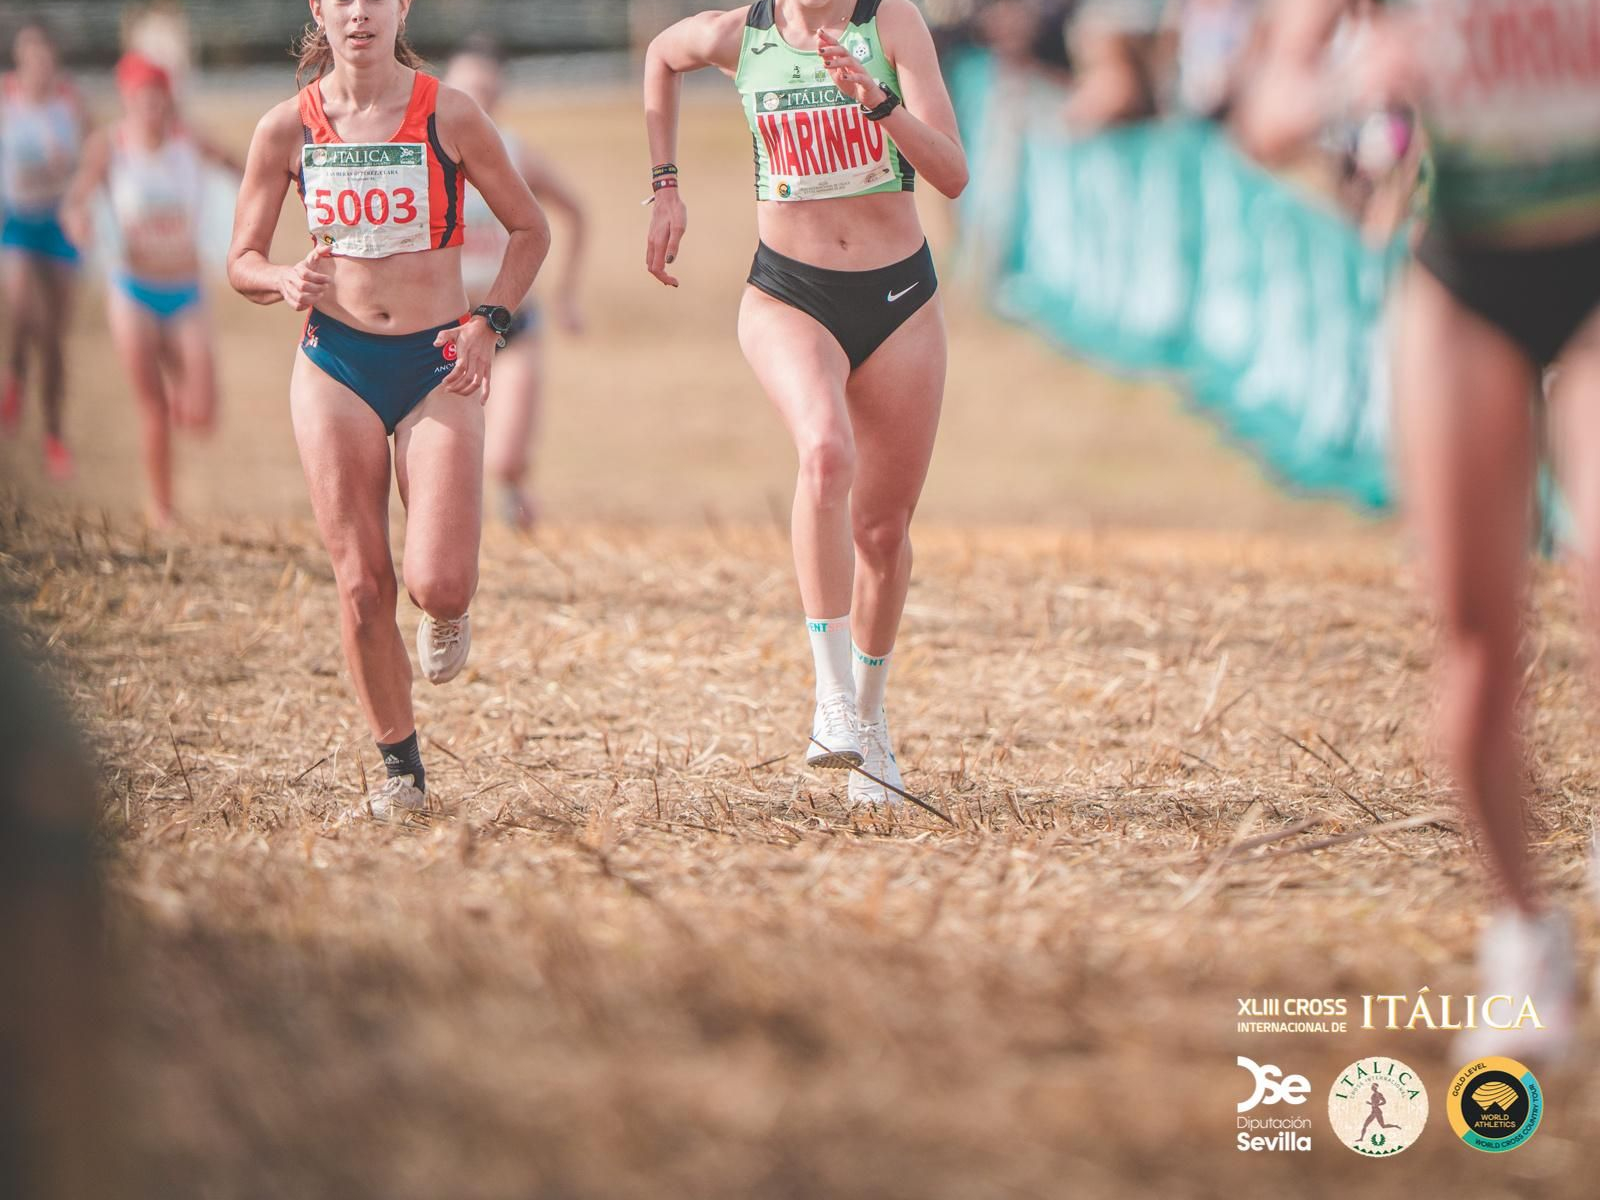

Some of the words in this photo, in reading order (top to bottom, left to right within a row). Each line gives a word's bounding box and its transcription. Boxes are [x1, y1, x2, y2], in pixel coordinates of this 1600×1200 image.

[787, 89, 845, 105] ITÁLICA
[757, 106, 884, 176] MARINHO
[315, 187, 418, 226] 5003
